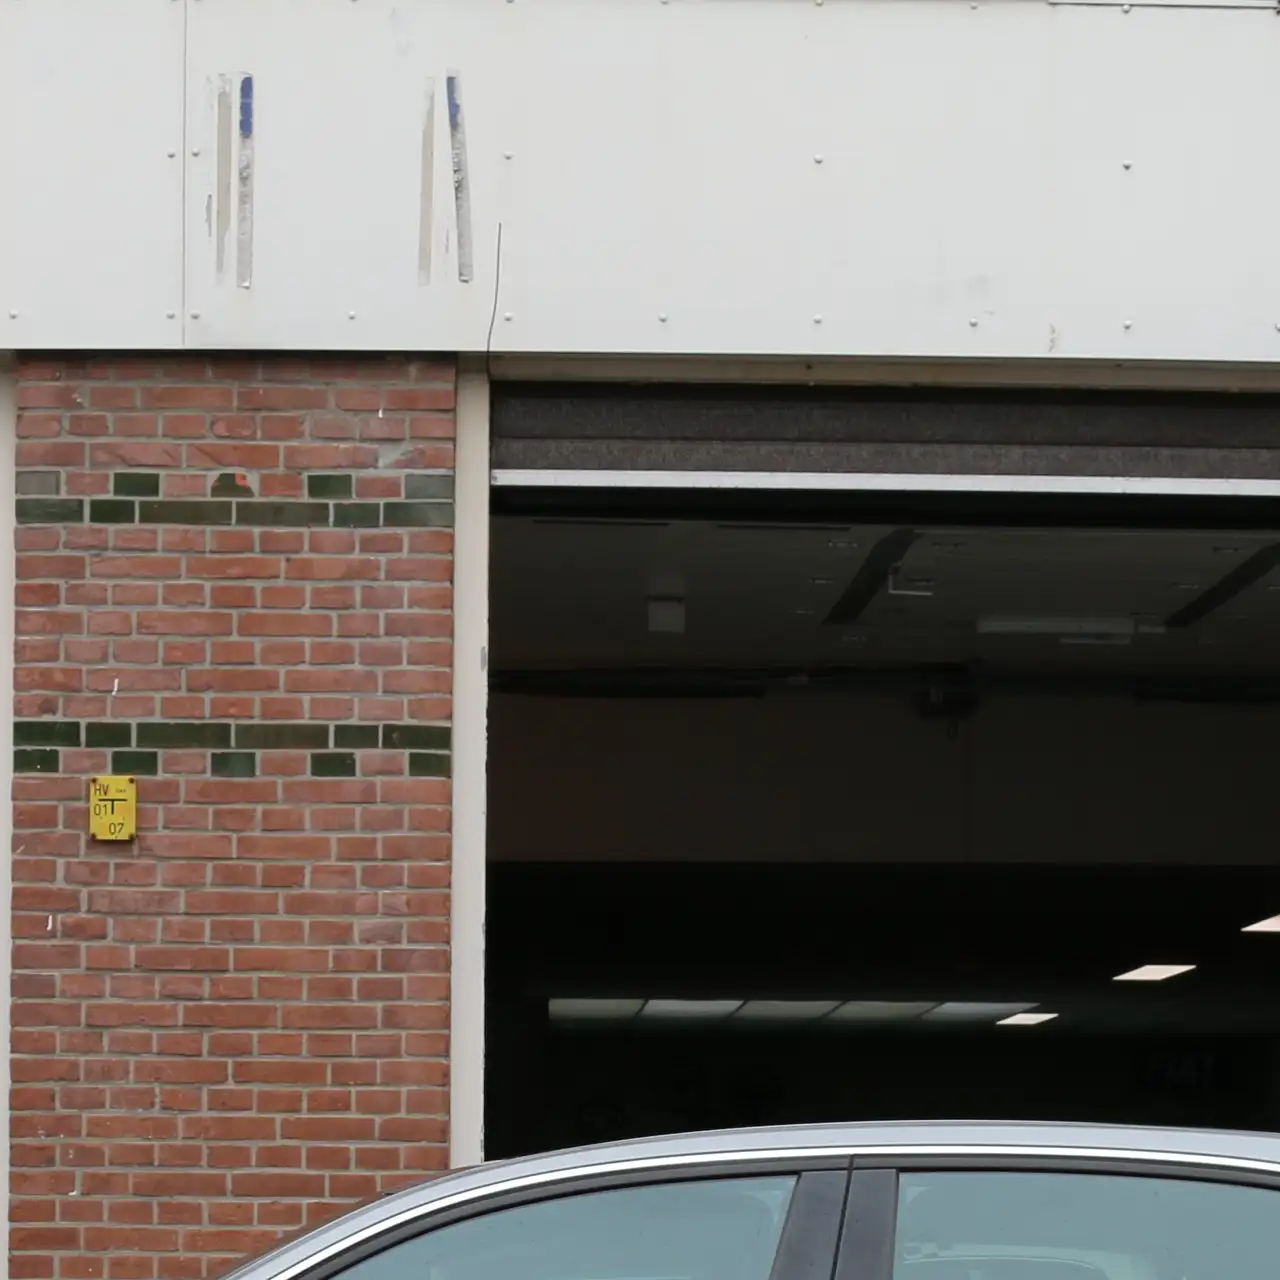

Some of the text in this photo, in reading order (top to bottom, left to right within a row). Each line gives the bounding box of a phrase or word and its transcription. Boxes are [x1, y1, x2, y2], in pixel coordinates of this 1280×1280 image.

[94, 784, 109, 796] HV
[94, 804, 107, 816] 01
[109, 822, 124, 835] 07
